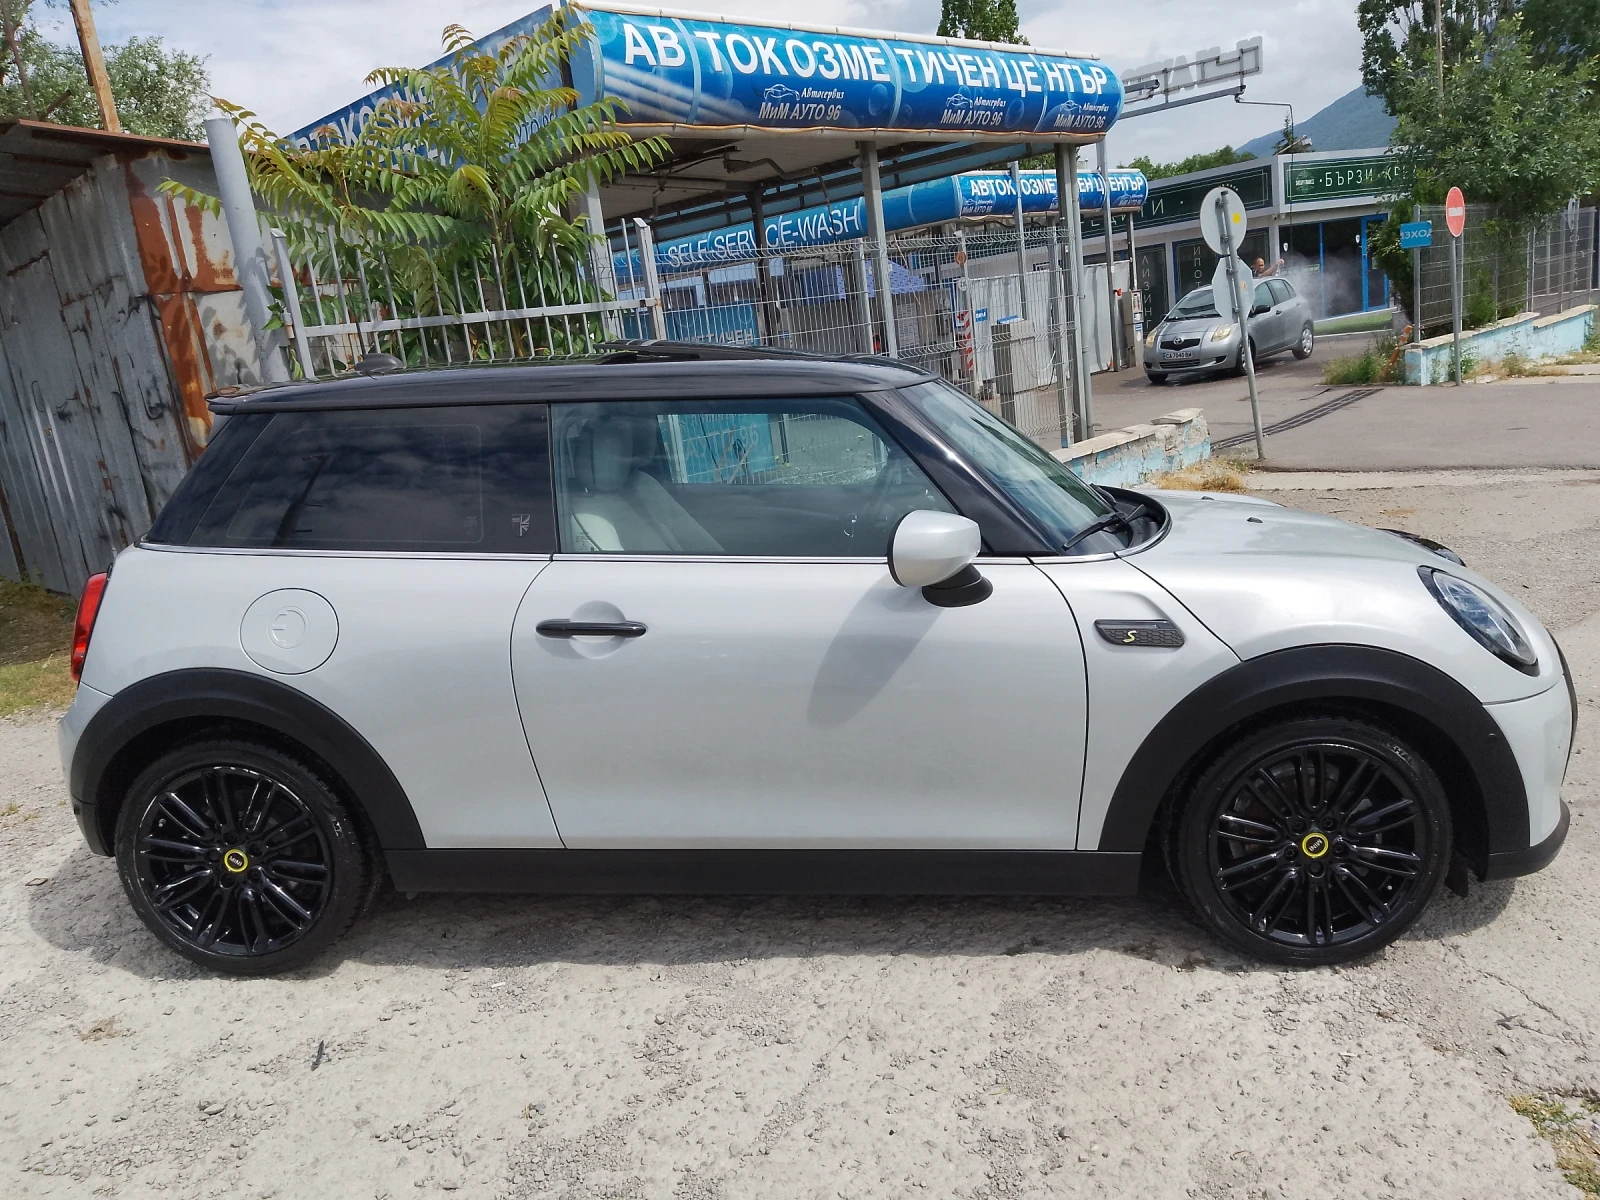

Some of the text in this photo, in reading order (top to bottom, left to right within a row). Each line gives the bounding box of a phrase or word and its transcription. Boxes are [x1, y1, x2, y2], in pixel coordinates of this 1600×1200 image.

[801, 87, 845, 101] Автосервиз
[974, 97, 1006, 109] Автосервиз
[758, 102, 842, 121] МиМ АУТО 96
[940, 109, 1003, 126] МиМ АУТО 96
[1053, 113, 1105, 129] МиМ АУТО 96
[1325, 168, 1373, 187] БЪРЗИ
[1142, 255, 1152, 329] ЛИЗИНГ
[1122, 629, 1138, 643] S
[228, 854, 243, 867] MINI
